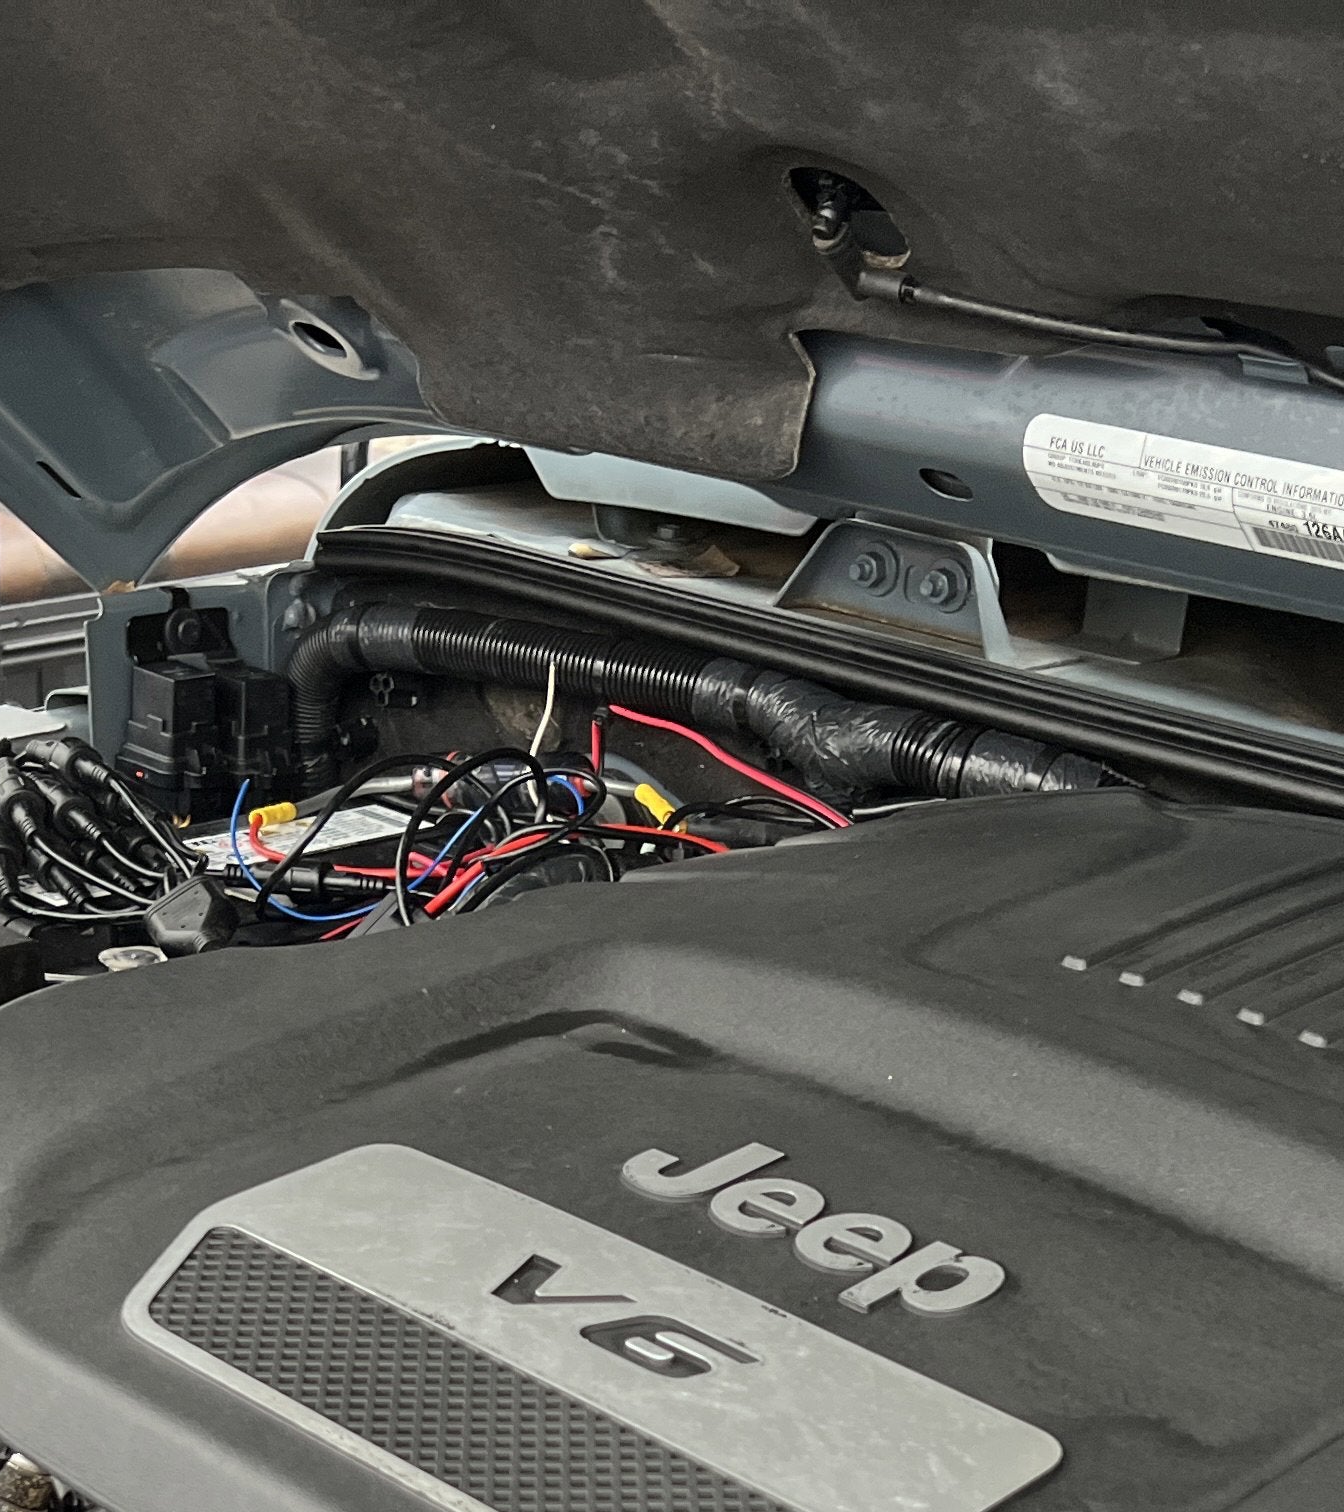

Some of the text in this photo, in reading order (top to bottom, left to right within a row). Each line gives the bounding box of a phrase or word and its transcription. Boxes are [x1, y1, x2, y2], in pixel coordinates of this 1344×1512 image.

[1049, 436, 1106, 458] FCA US LLC
[1143, 455, 1182, 474] VEHICLE
[1184, 464, 1231, 484] EMISSION
[1233, 472, 1278, 494] CONTROL
[619, 1141, 1008, 1318] Jeep
[490, 1252, 764, 1380] V6
